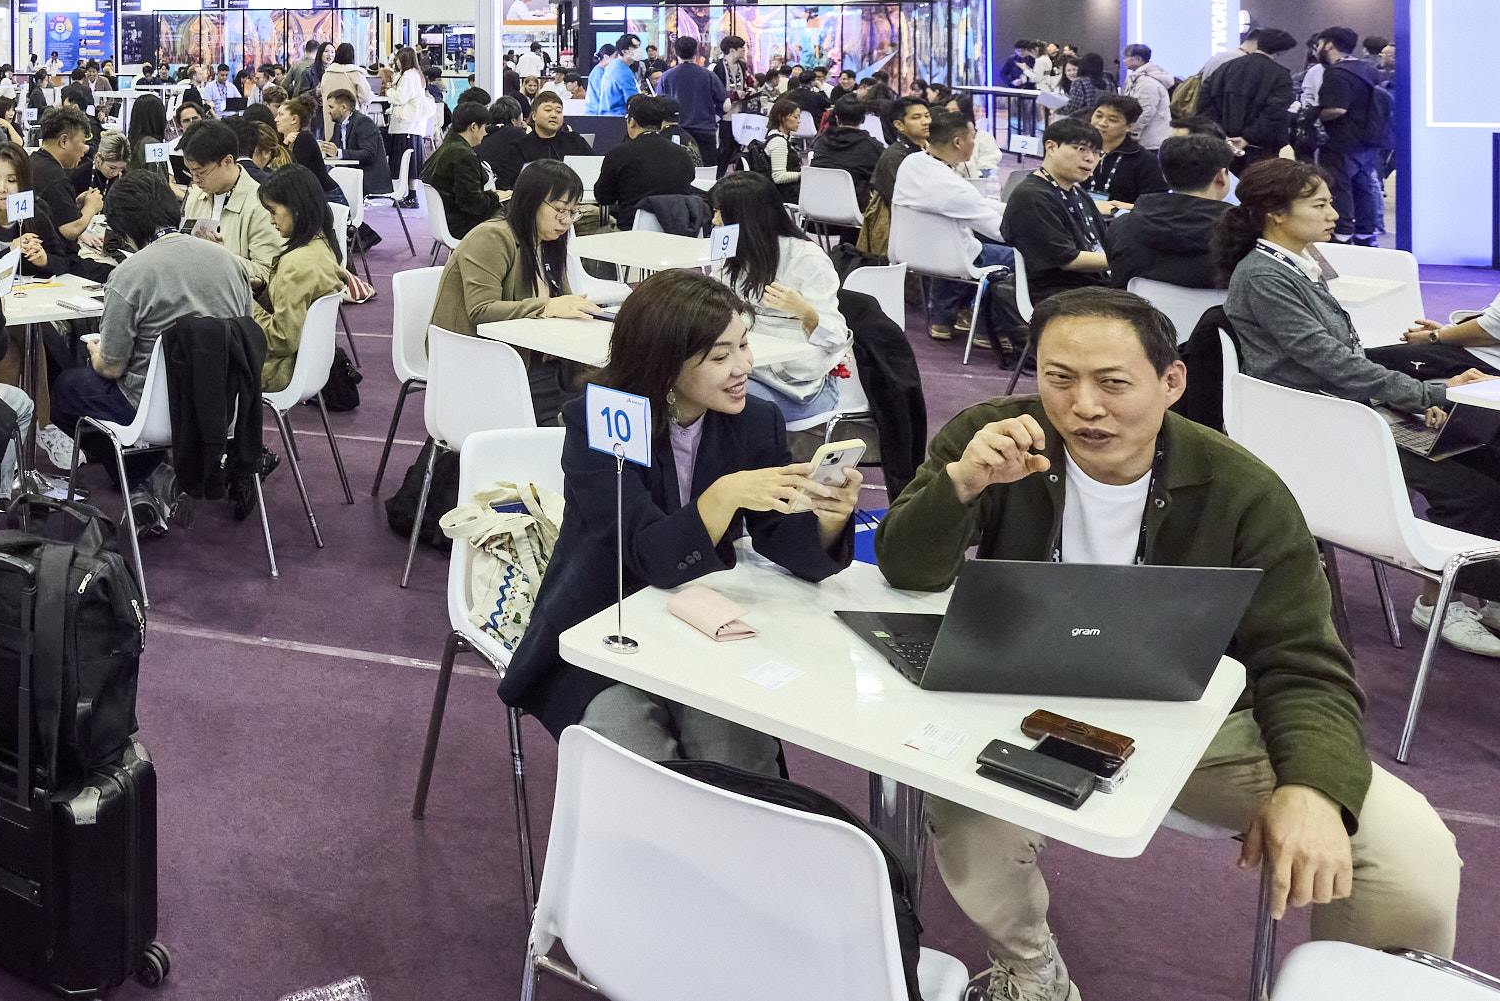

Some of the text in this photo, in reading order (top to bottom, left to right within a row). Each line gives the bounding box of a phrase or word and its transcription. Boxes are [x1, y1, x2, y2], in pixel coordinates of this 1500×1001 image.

[1021, 141, 1028, 149] 2
[152, 148, 164, 158] 13
[15, 199, 27, 213] 14
[721, 235, 730, 251] 9
[601, 407, 631, 443] 10
[1071, 628, 1101, 637] gram
